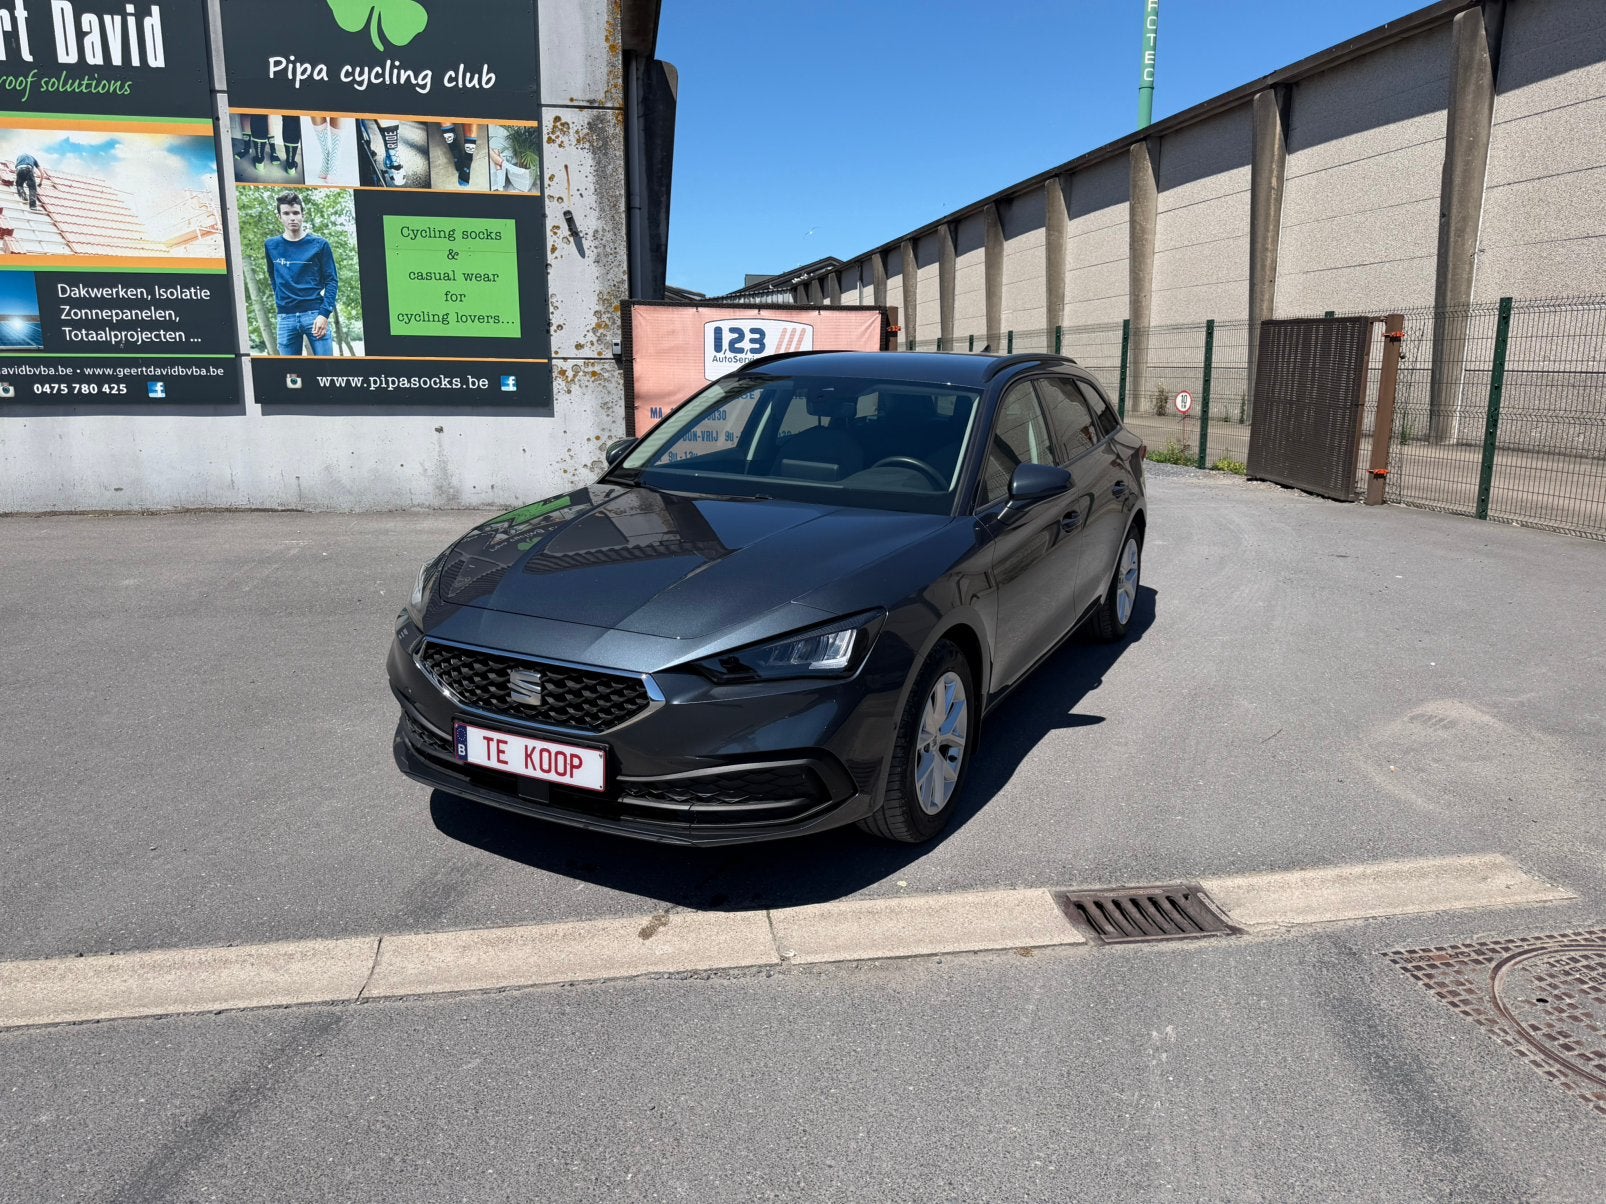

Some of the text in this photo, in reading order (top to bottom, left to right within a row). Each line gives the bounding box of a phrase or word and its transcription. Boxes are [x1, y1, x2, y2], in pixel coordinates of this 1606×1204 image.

[51, 0, 166, 68] David
[268, 55, 496, 94] Pipa cycling club
[40, 71, 133, 95] solutions
[400, 225, 502, 241] Cycling socks
[446, 248, 460, 260] &
[408, 269, 500, 283] casual wear
[57, 284, 210, 300] Dakwerken, Isolatie
[444, 290, 466, 303] for
[60, 306, 180, 323] Zonnepanelen,
[396, 310, 515, 325] cycling lovers...
[62, 327, 186, 345] Totaalprojecten
[712, 355, 757, 364] AutoServi
[83, 365, 225, 379] www.geertdavidbvba.be
[33, 383, 127, 395] 0475 780 425
[316, 375, 489, 391] www.pipasocks.be
[458, 744, 466, 756] B
[483, 735, 583, 779] TE KOOP
